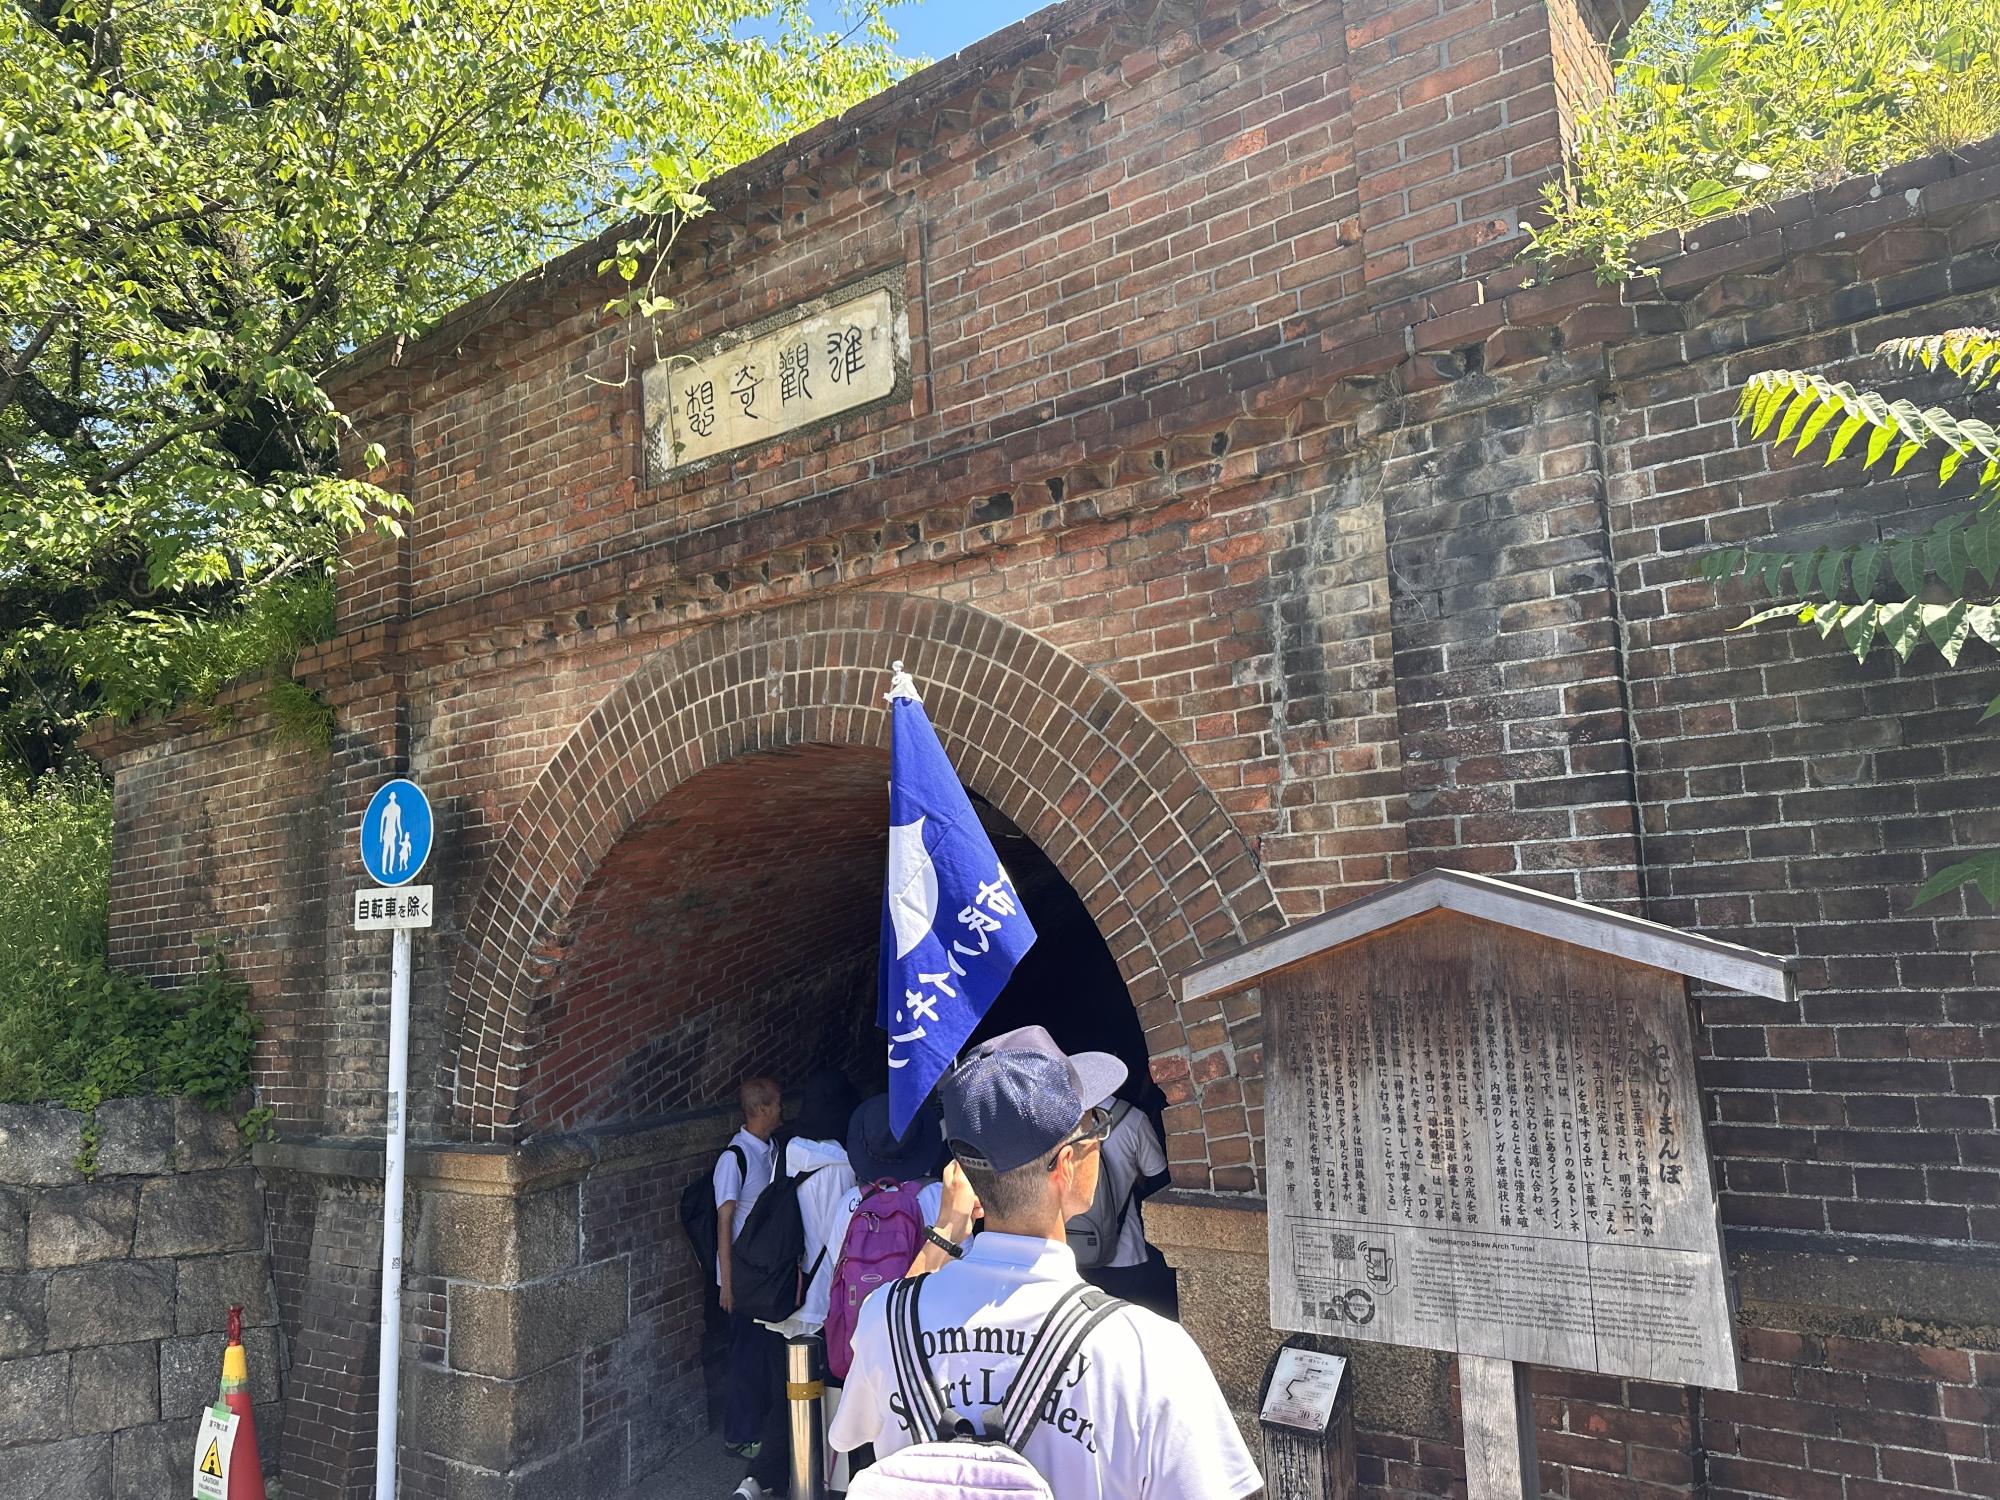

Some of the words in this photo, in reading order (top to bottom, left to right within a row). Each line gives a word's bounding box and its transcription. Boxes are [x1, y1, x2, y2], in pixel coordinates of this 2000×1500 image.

[358, 895, 429, 920] 自転車を除く
[1358, 991, 1373, 1071] という意味です。
[1648, 1031, 1683, 1185] ねじりまんぽ
[1471, 1240, 1491, 1249] Skew
[1492, 1242, 1509, 1250] Arch
[1511, 1243, 1535, 1252] Tunnel
[921, 1325, 1092, 1388] ommuy
[889, 1371, 973, 1431] Srt
[979, 1367, 1097, 1453] Lders
